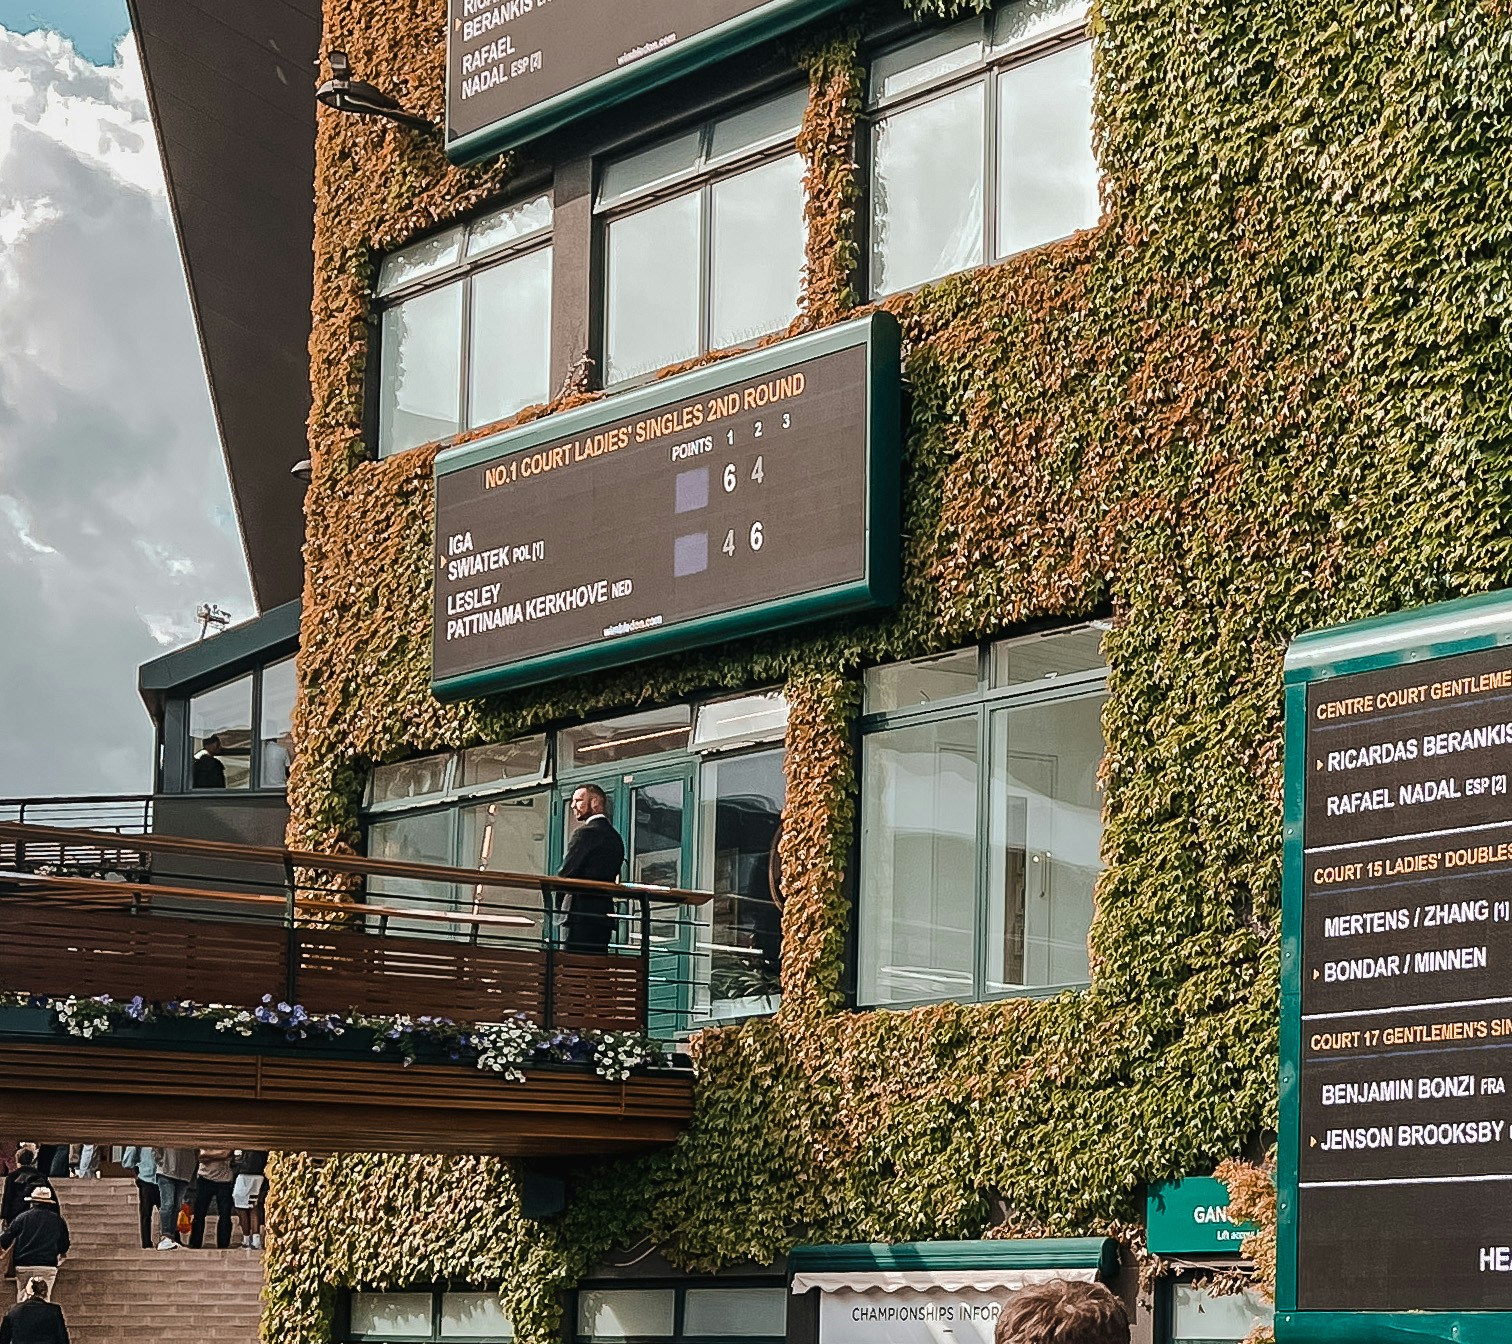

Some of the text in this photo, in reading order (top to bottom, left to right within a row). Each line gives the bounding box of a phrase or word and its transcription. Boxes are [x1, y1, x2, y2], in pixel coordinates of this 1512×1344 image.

[463, 35, 515, 75] RAFAEL
[462, 64, 508, 99] NADAL
[486, 373, 804, 489] NO.1 COURT LADIES' SINGLES 2ND ROUND
[672, 436, 712, 461] POINTS
[449, 532, 473, 555] IGA
[448, 546, 509, 580] SWIATEK
[447, 580, 632, 640] PATTINAMA KERKHOVE NED
[448, 583, 500, 615] LESLEY
[1317, 696, 1373, 719] CENTRE
[1377, 685, 1428, 709] COURT
[1328, 739, 1418, 771] RICARDAS
[1328, 778, 1461, 816] RAFAEL NADAL
[1314, 864, 1363, 884] COURT
[1367, 861, 1382, 877] 15
[1386, 853, 1441, 875] LADIES'
[1325, 900, 1509, 937] MERTENS ZHANG [1]
[1325, 947, 1486, 982] BONDAR MINNEN
[1311, 1032, 1360, 1050] COURT
[1364, 1030, 1379, 1046] 17
[1383, 1021, 1487, 1044] GENTLEMEN'S
[1322, 1075, 1505, 1105] BENJAMIN BONZI FRA
[1321, 1120, 1504, 1150] JENSON BROOKSBY
[1193, 1205, 1228, 1224] GAN
[852, 1306, 1000, 1322] CHAMPIONSHIPS INFOR
